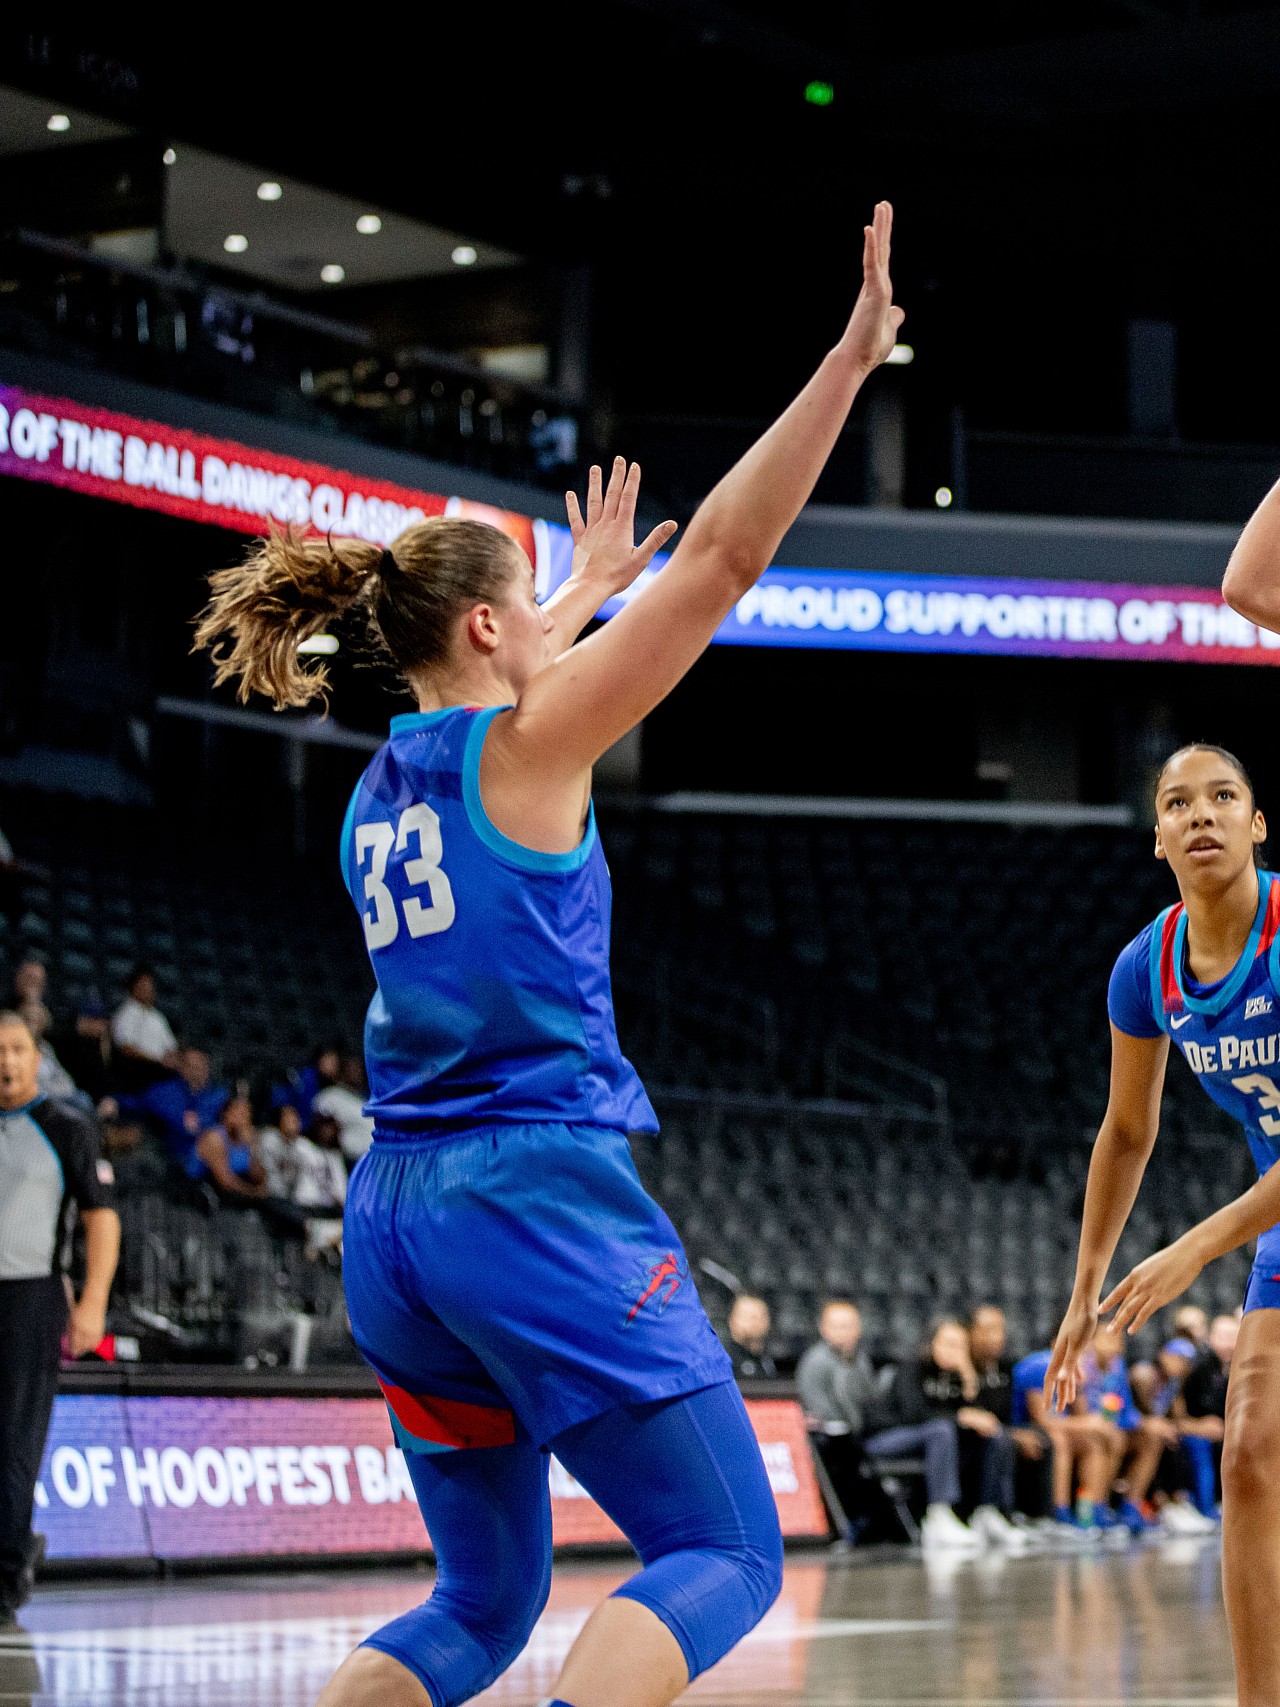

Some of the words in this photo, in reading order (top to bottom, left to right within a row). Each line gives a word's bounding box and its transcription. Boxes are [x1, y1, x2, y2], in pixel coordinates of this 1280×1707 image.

[11, 408, 59, 462] OF
[58, 418, 123, 481] THE
[123, 435, 201, 500] BALL
[736, 584, 883, 632] PROUD
[883, 589, 1118, 643] SUPPORTER
[1118, 600, 1177, 645] OF
[355, 801, 456, 950] 33
[51, 1446, 116, 1509] OF
[120, 1446, 351, 1509] HOOPFEST
